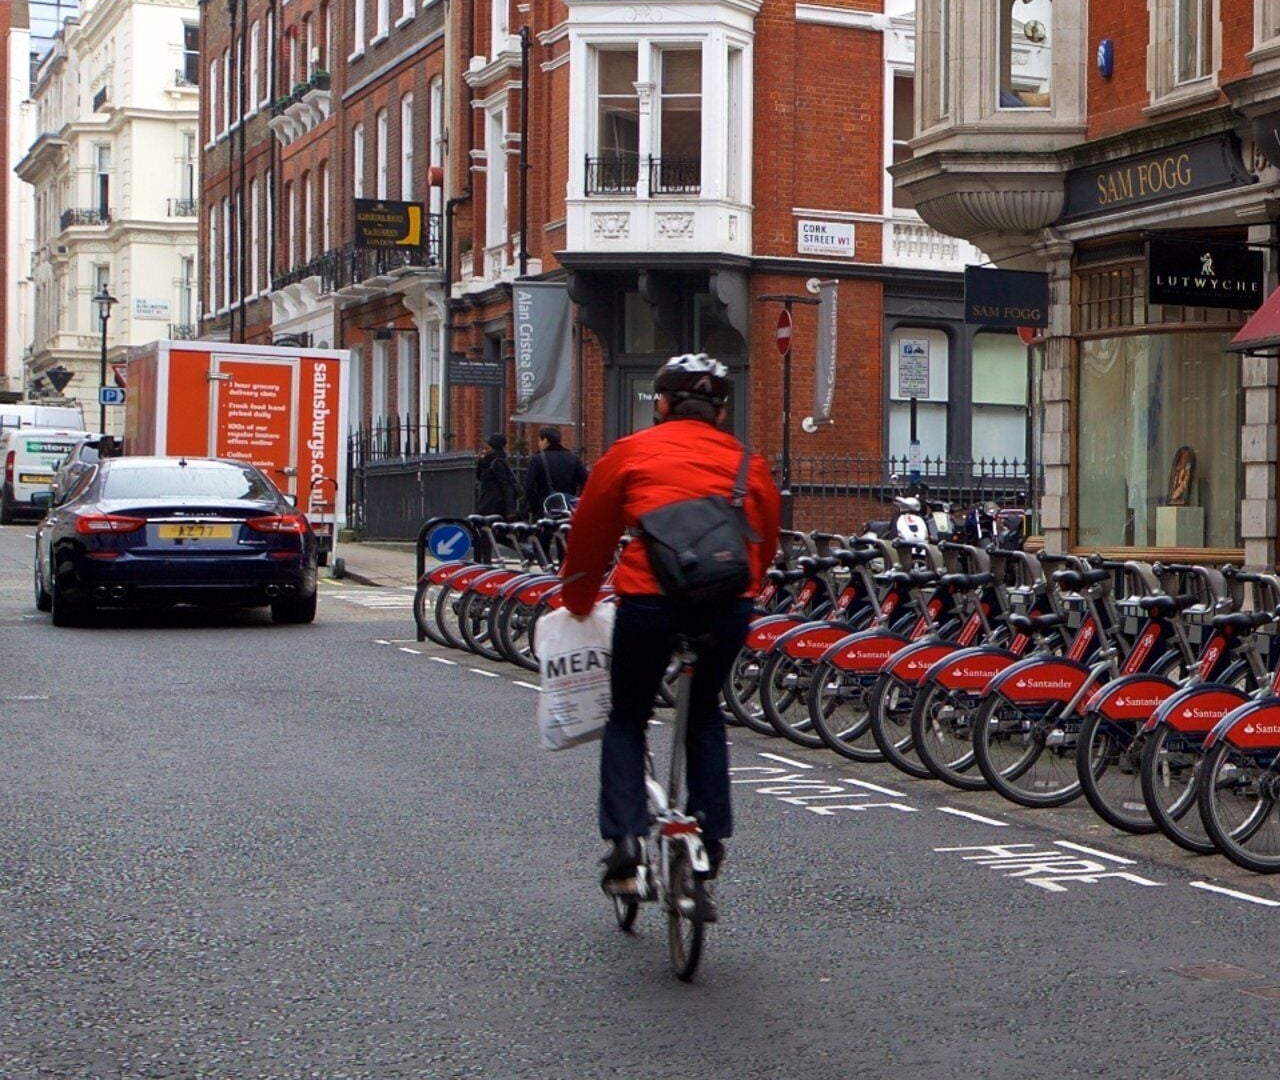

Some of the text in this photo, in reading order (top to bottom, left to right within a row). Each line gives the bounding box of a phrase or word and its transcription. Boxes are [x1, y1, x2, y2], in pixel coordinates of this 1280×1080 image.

[1096, 154, 1192, 205] SAM FOGG
[803, 224, 827, 234] CORK
[803, 234, 849, 246] STREET W1
[1156, 275, 1259, 292] LUTWYCHE
[518, 291, 533, 320] Alan
[972, 305, 1041, 320] SAM FOGG
[518, 323, 534, 368] Cristea
[252, 384, 280, 392] grocery
[106, 390, 116, 400] P
[638, 393, 652, 401] The
[963, 668, 999, 677] Santand
[1027, 679, 1072, 689] Santander
[1125, 696, 1163, 706] Santande
[933, 843, 1168, 893] HIRE
